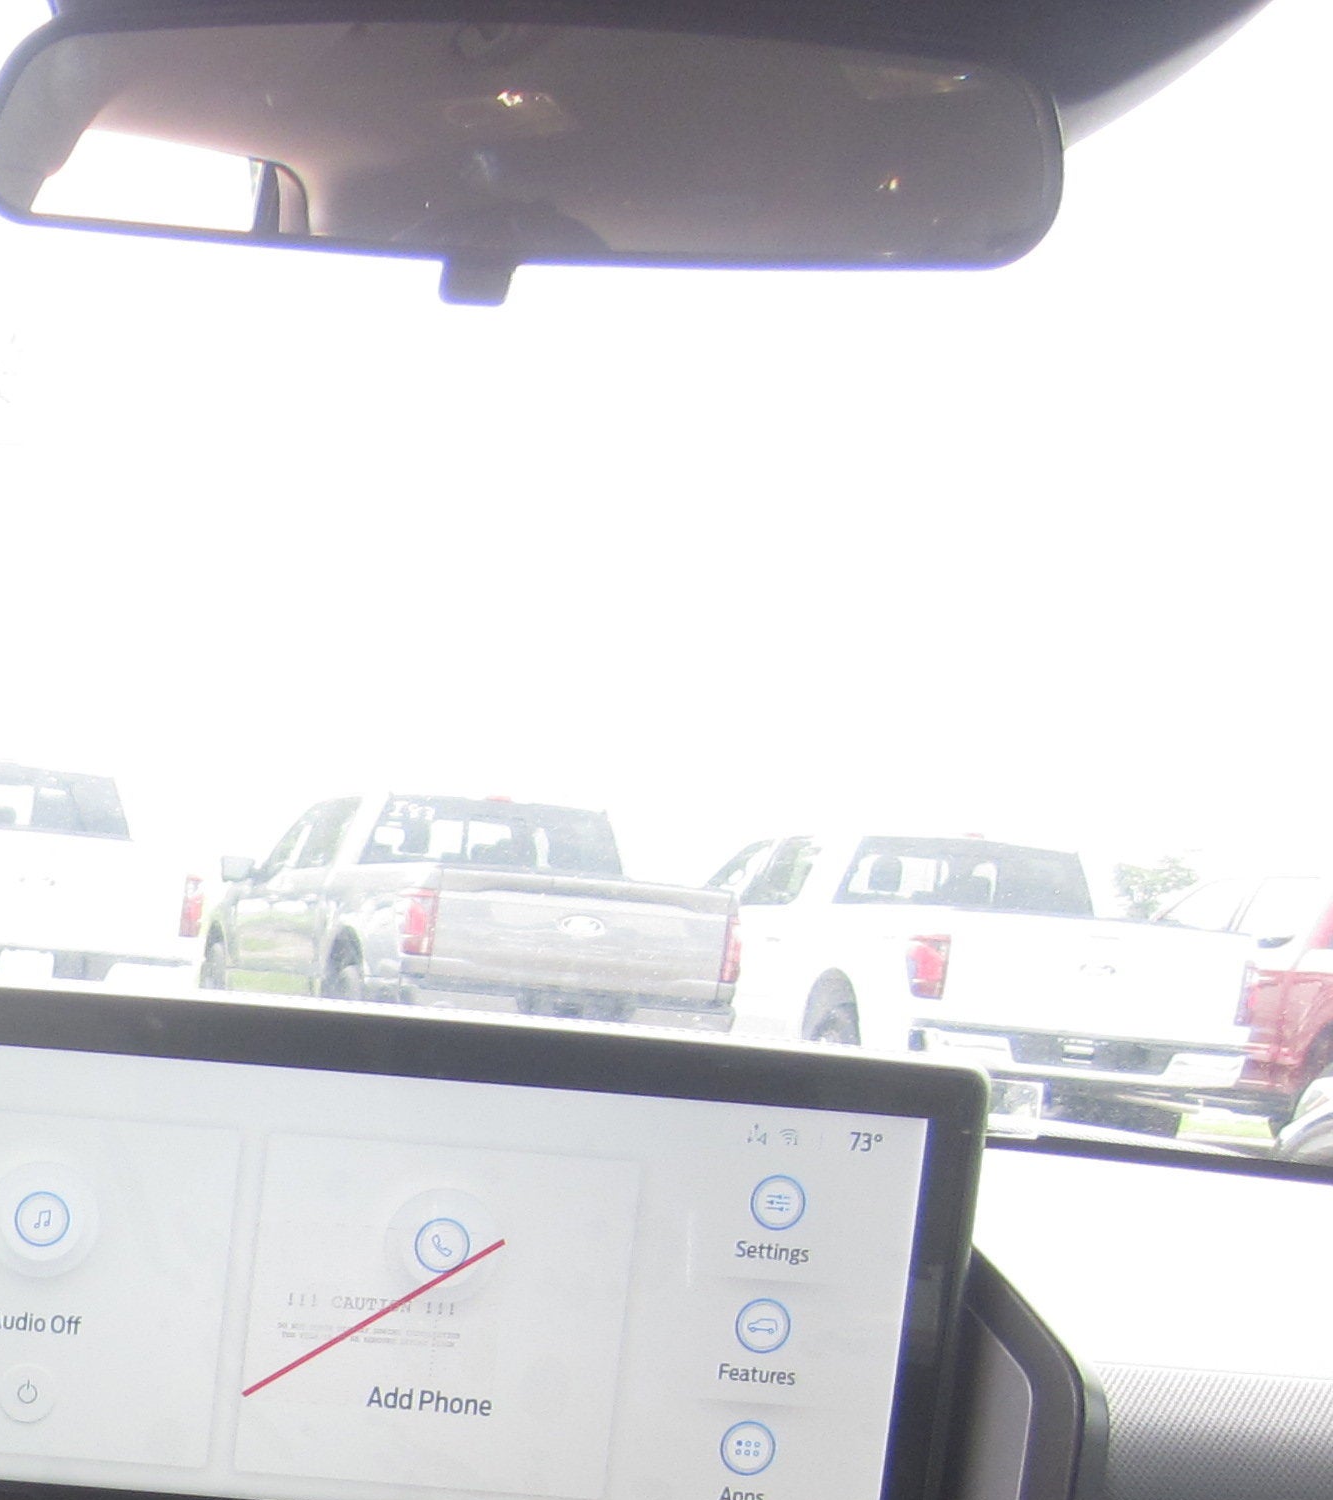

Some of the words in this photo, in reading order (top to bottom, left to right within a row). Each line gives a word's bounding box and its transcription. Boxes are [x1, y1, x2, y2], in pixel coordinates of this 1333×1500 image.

[849, 1131, 883, 1152] 73°
[734, 1239, 810, 1266] Settings
[50, 1314, 82, 1335] Off
[718, 1362, 796, 1387] Features
[366, 1386, 414, 1411] Add
[418, 1390, 493, 1417] Phone
